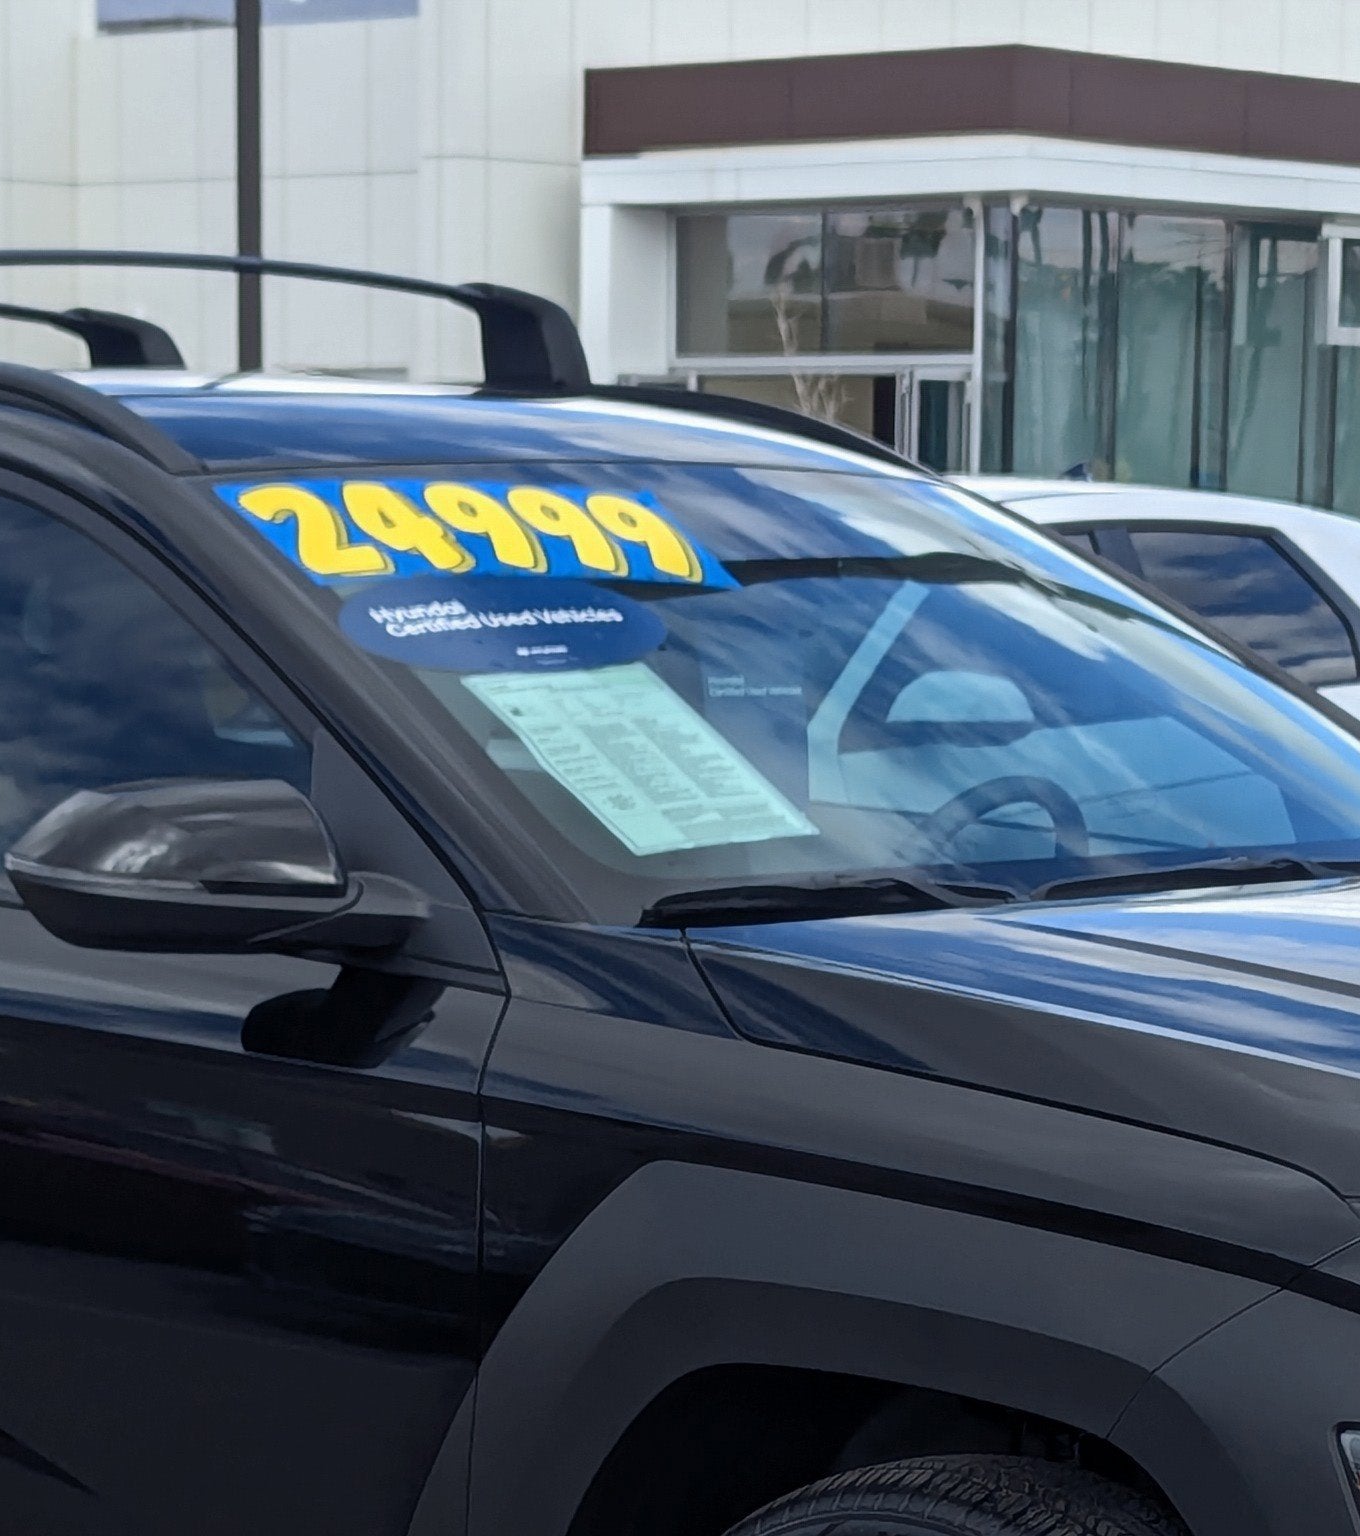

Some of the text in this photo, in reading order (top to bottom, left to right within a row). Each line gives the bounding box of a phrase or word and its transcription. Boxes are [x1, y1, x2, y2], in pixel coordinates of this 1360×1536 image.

[238, 483, 703, 583] 24999
[368, 599, 467, 624] Hyundai
[386, 606, 624, 637] Certified Used Vehicles
